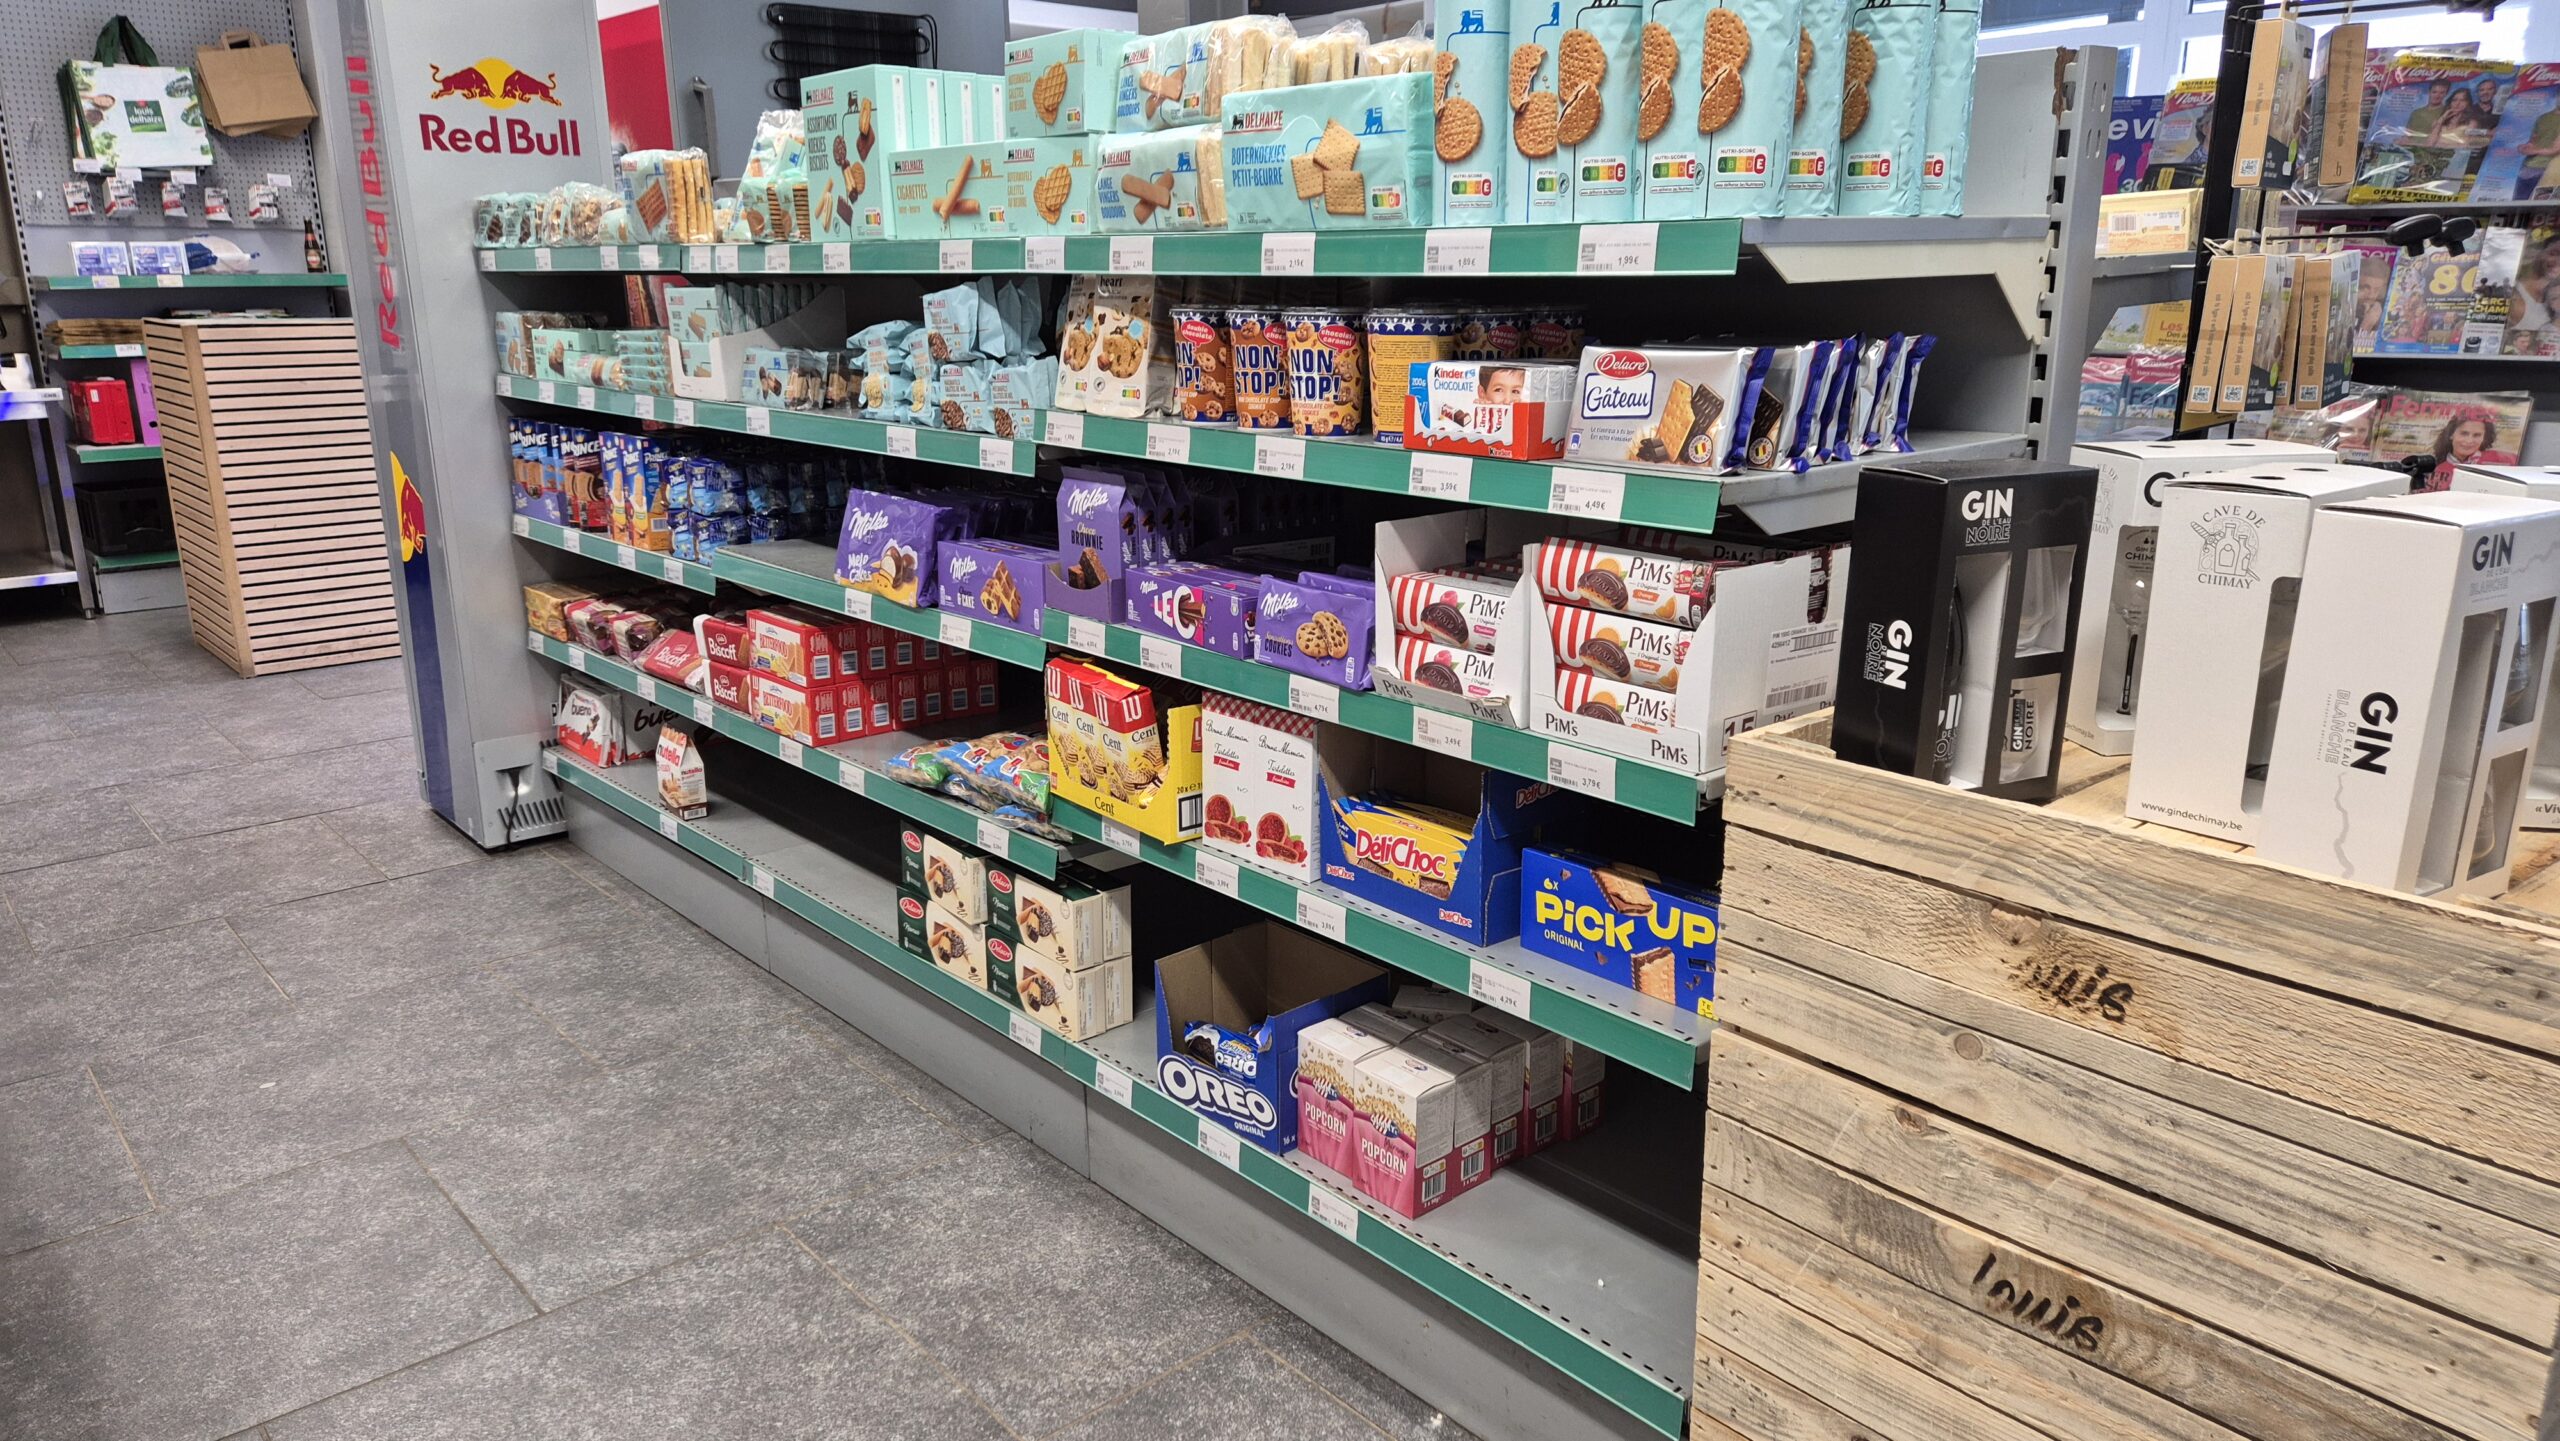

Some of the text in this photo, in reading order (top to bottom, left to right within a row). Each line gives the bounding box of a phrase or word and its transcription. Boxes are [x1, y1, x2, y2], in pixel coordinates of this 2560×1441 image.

[1244, 110, 1283, 129] DELHAIZE
[419, 113, 581, 156] Red Bull
[1231, 144, 1286, 166] BOTERKOEKJES
[1232, 167, 1283, 187] PETIT-BEURRE
[896, 184, 928, 200] CIGARETTES
[1618, 256, 1639, 267] 1,99€
[1321, 329, 1356, 340] chocolate
[1323, 336, 1352, 346] caramel
[1235, 345, 1279, 370] NON
[1290, 348, 1334, 374] NON
[1600, 354, 1646, 371] Delacre
[1235, 371, 1286, 395] STOP!
[1289, 375, 1341, 401] STOP!
[1434, 378, 1473, 392] CHOCOLATE
[1586, 386, 1649, 412] Gâteau
[1068, 487, 1109, 515] Milka
[1584, 501, 1606, 511] 4,49€
[1961, 487, 2014, 521] GIN
[849, 507, 889, 540] Milka
[2202, 505, 2267, 529] CAVE DE
[1071, 530, 1104, 551] BROWNIE
[1966, 523, 2011, 545] NOIRE
[2472, 531, 2515, 572] GIN
[950, 556, 978, 580] Milka
[1629, 556, 1672, 585] PiM's
[2198, 573, 2254, 590] CHIMAY
[1260, 592, 1299, 617] Milka
[708, 638, 737, 661] Biscoff
[1264, 638, 1293, 657] COOKIES
[1629, 626, 1672, 656] PiM's
[1866, 623, 1885, 683] NOIRE
[655, 648, 690, 667] Biscoff
[1883, 619, 1913, 690] GIN
[713, 679, 738, 703] Biscoff
[1383, 679, 1413, 699] PiM's
[572, 702, 591, 716] bueno
[1051, 706, 1070, 724] Cent
[1121, 695, 1143, 723] LU
[1471, 702, 1504, 722] PiM's
[1625, 691, 1669, 722] PiM's
[1076, 717, 1094, 736] Cent
[1131, 726, 1157, 743] Cent
[1545, 712, 1578, 737] PiM's
[2024, 700, 2035, 750] NOIRE
[2325, 689, 2351, 765] BLANCHE
[2350, 691, 2399, 775] GIN
[1102, 733, 1122, 752] Cent
[1259, 735, 1278, 752] Bonne
[1651, 738, 1688, 765] PiM's
[658, 744, 680, 767] nutella
[1094, 796, 1115, 816] Cent
[2141, 802, 2243, 832] www.gindechimay.be
[1356, 829, 1447, 877] DéliChoc
[1326, 864, 1355, 881] DéliChoc
[1439, 909, 1472, 928] DéliChoc
[1646, 900, 1716, 949] UP
[1544, 929, 1585, 951] ORIGINAL
[1162, 1058, 1274, 1129] OREO
[1234, 1122, 1266, 1138] ORIGINAL
[1305, 1102, 1346, 1136] POPCORN
[1361, 1138, 1407, 1176] POPCORN
[1972, 1252, 2105, 1354] louis
